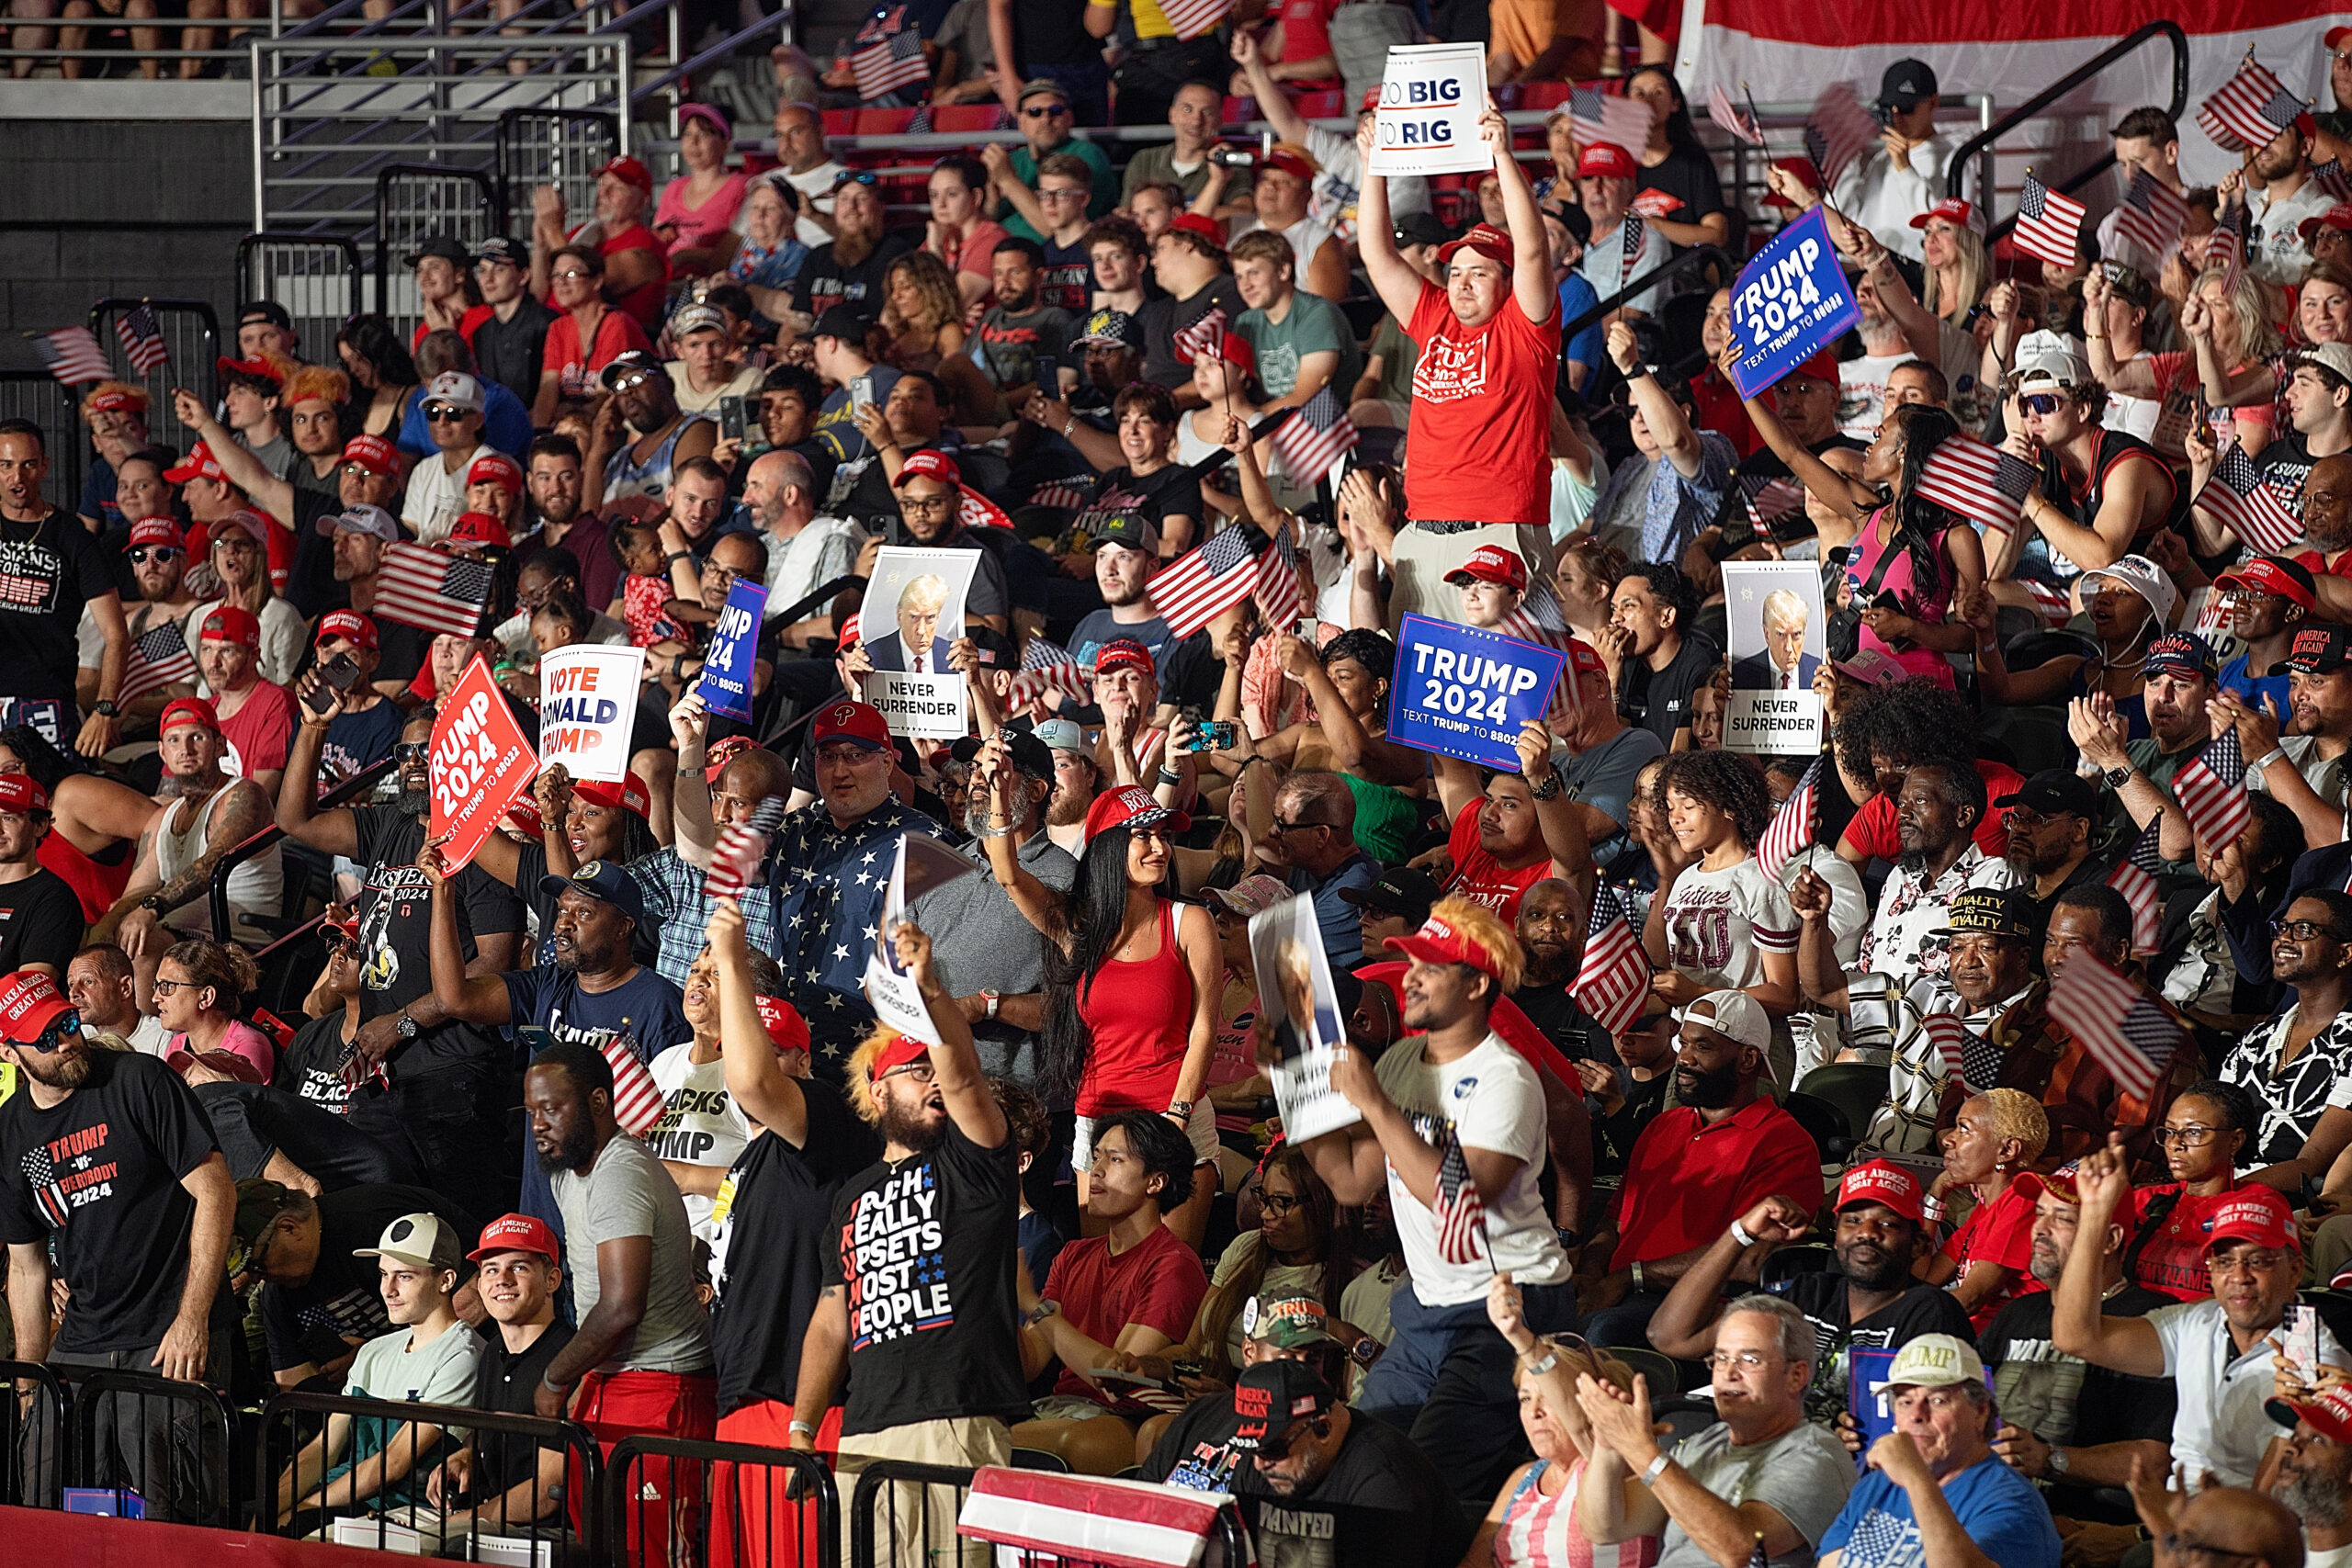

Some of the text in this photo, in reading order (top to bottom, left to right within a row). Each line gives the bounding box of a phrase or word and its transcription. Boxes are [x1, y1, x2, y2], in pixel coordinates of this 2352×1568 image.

[1381, 78, 1461, 104] OO BIG
[1402, 119, 1452, 144] RIG
[1734, 237, 1819, 324] TRUMP
[1747, 274, 1820, 346] 2024
[1744, 347, 1769, 371] TEXT
[1769, 324, 1800, 354] TRUMP
[1800, 314, 1814, 331] TO
[454, 522, 477, 536] SA
[0, 541, 57, 571] SIANS
[718, 604, 752, 642] UMP
[705, 638, 735, 672] 24
[2149, 637, 2193, 655] TRUMP
[550, 667, 600, 695] VOTE
[1413, 641, 1538, 696] TRUMP
[707, 674, 744, 694] TO 88022
[888, 681, 935, 698] NEVER
[542, 697, 618, 731] DONALD
[872, 697, 957, 716] SURRENDER
[1422, 679, 1508, 726] 2024
[1751, 699, 1798, 714] NEVER
[1402, 708, 1430, 725] TEXT
[1432, 716, 1470, 734] TRUMP
[1473, 726, 1487, 739] TO
[1732, 717, 1815, 731] SURRENDER
[542, 728, 603, 760] TRUMP
[0, 780, 23, 791] MERICA
[436, 731, 498, 818] 2024
[461, 788, 485, 823] TRUMP
[483, 774, 497, 792] TO
[495, 745, 521, 779] 88022
[515, 795, 542, 815] MERIC
[395, 889, 428, 901] 2024
[1951, 895, 2005, 909] LOYALTY
[18, 972, 50, 994] AMERICA
[7, 983, 55, 1021] GREAT AGAIN
[591, 1026, 619, 1036] President
[663, 1088, 729, 1116] ACKS
[47, 1122, 108, 1164] TRUMP
[650, 1130, 714, 1161] UMP
[1847, 1179, 1905, 1196] GREAT AGAIN
[1869, 1167, 1910, 1190] AMERICA
[70, 1182, 113, 1208] 2024
[840, 1190, 936, 1253] REALLY
[2234, 1202, 2274, 1218] AMERICA
[2241, 1212, 2270, 1227] AGAIN
[501, 1219, 532, 1229] AMERICA
[505, 1226, 528, 1235] AGAIN
[841, 1220, 943, 1281] UPSETS
[848, 1258, 915, 1310] MOST
[850, 1282, 953, 1340] PEOPLE
[1293, 1314, 1317, 1325] 2024
[1228, 1436, 1259, 1449] 2024
[635, 1493, 662, 1501] aidas
[1260, 1501, 1335, 1540] WANTED
